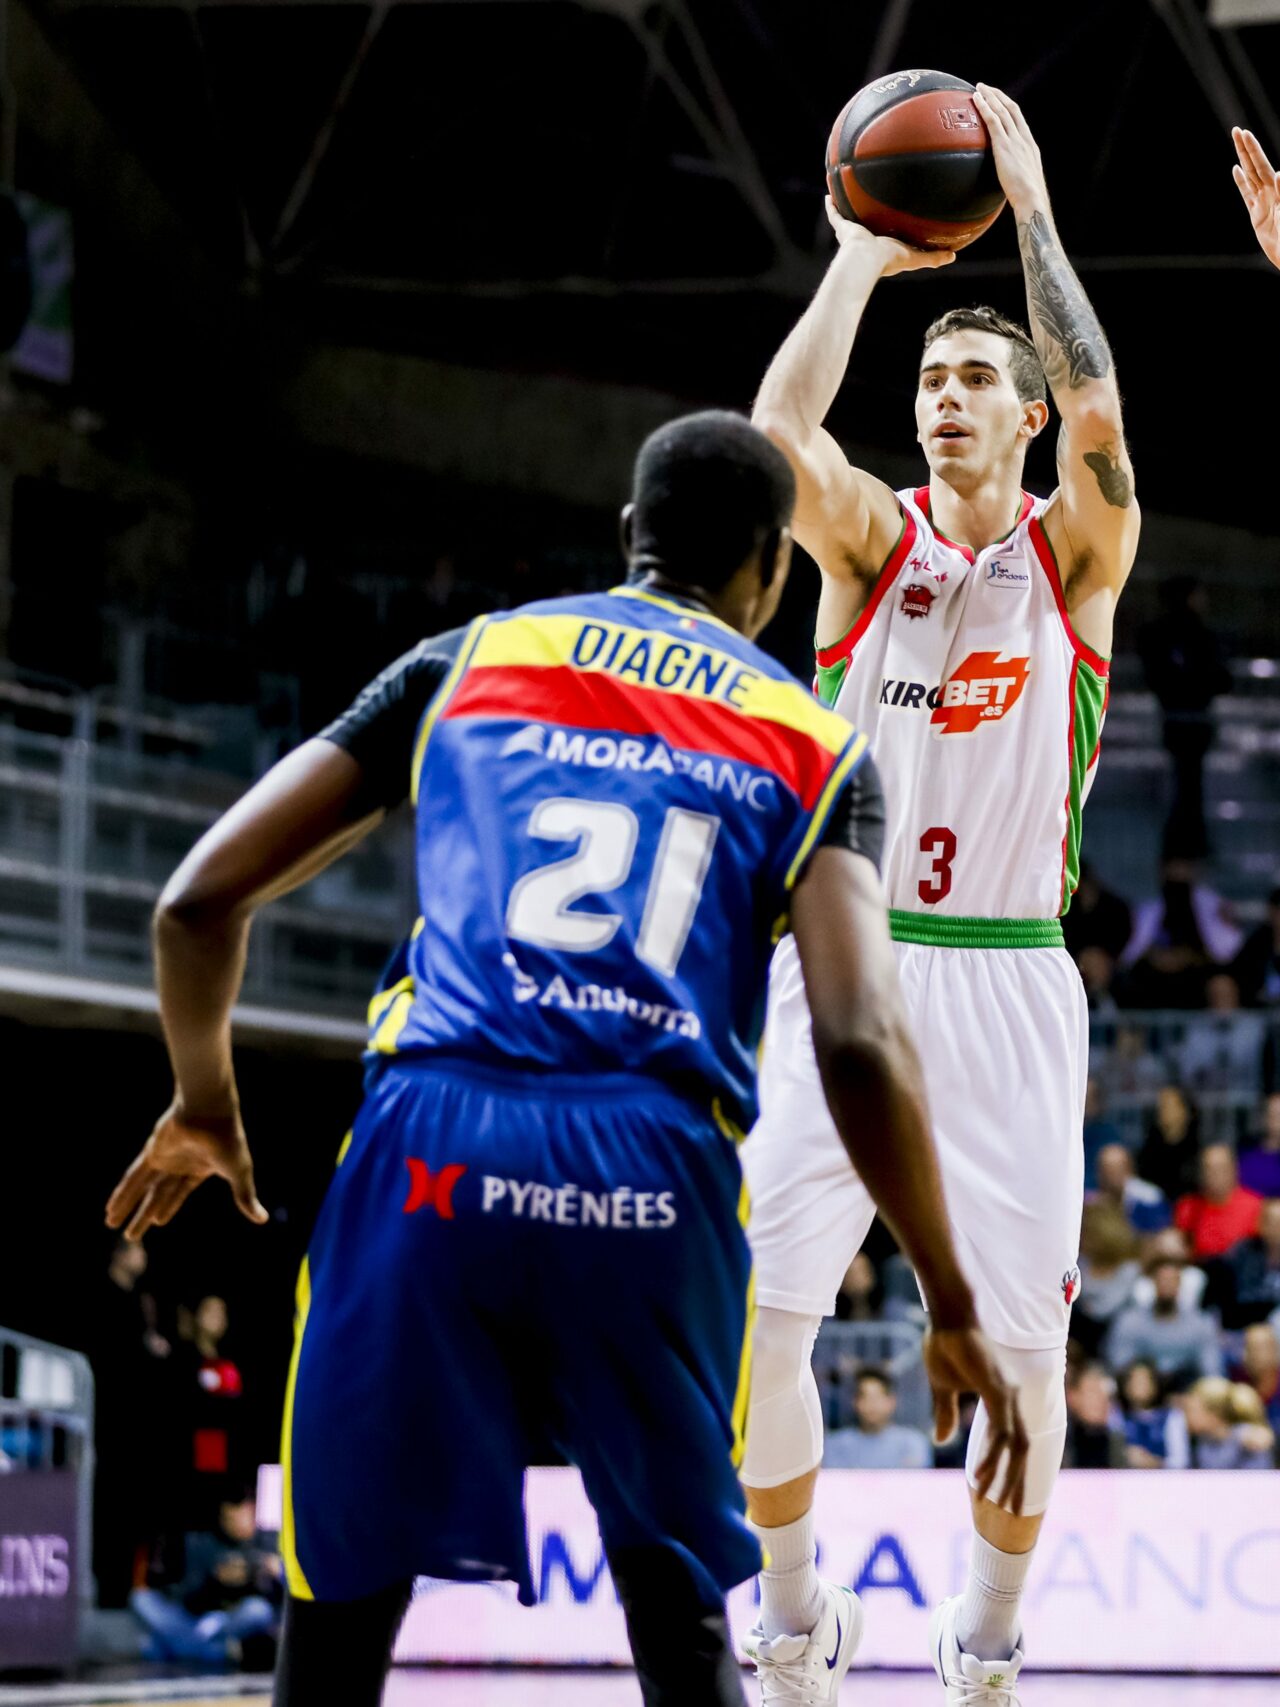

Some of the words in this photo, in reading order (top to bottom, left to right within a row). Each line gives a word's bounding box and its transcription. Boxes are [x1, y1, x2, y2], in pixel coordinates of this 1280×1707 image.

[572, 624, 759, 708] DIAGNE
[507, 797, 721, 978] 21
[917, 826, 958, 904] 3
[481, 1175, 678, 1229] PYRÉNÉES
